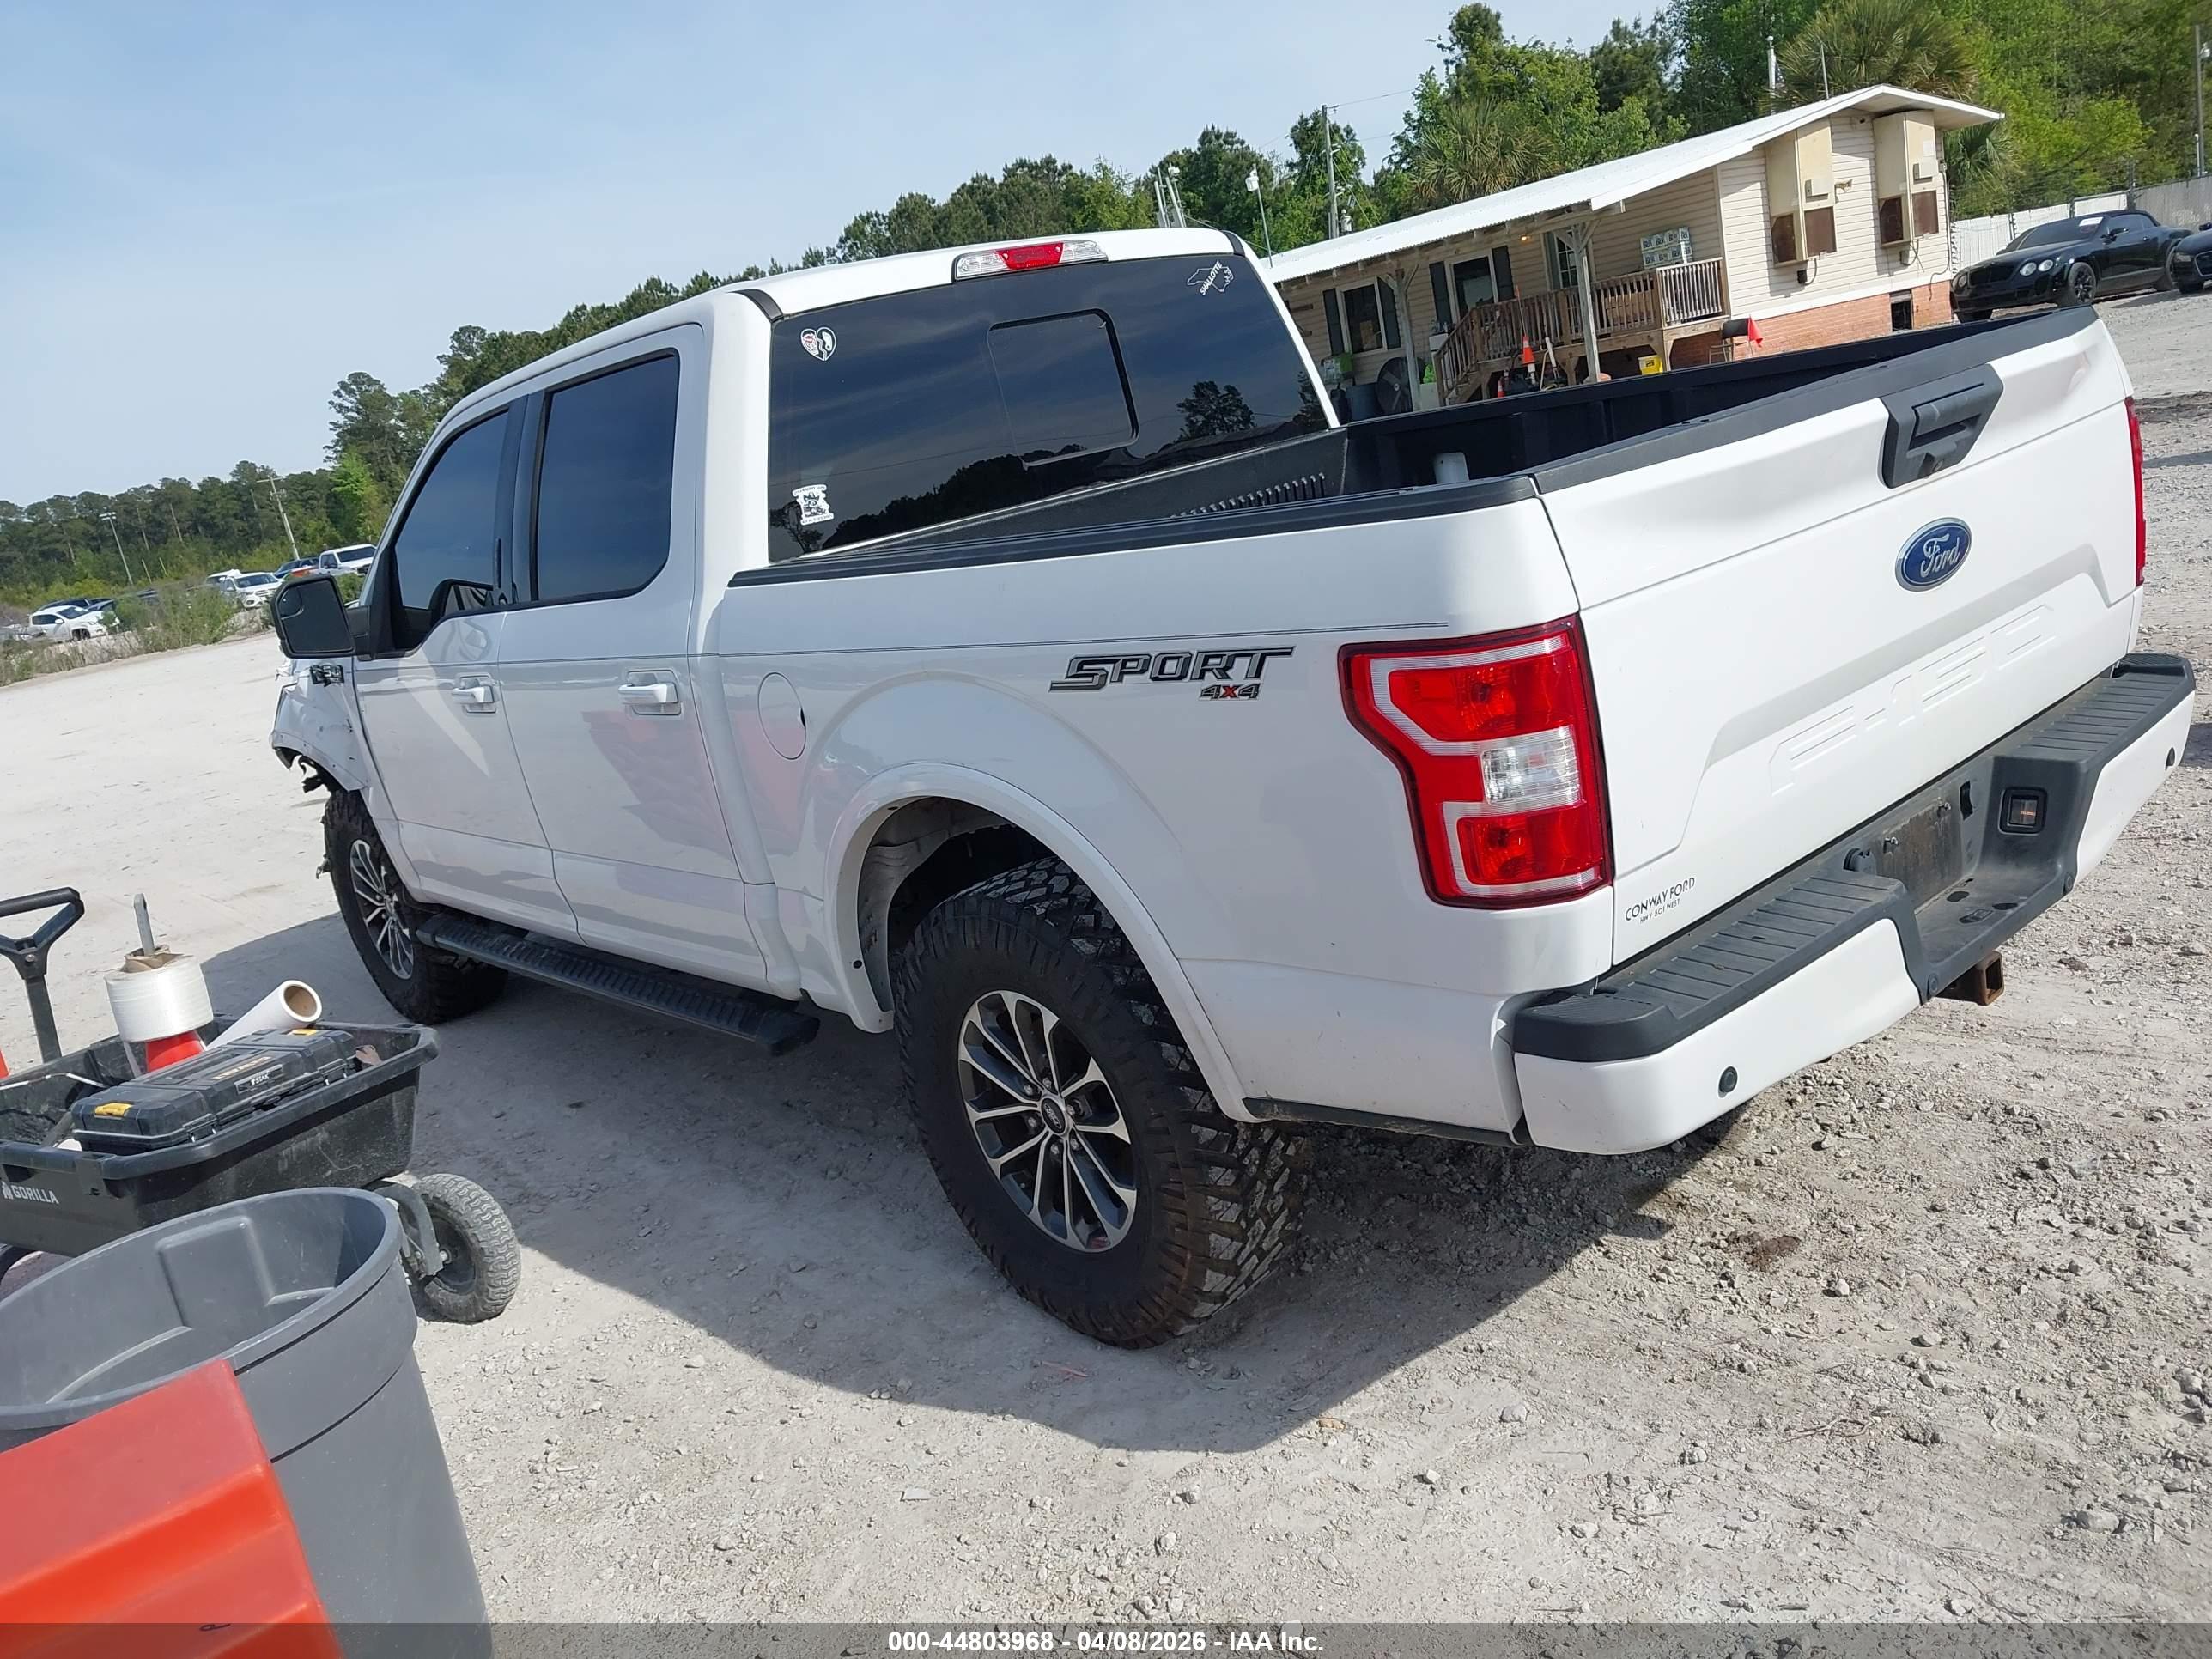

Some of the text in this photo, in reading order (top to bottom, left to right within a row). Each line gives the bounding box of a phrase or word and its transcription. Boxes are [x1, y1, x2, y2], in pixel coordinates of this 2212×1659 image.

[1919, 532, 1960, 578] Ford
[1048, 646, 1295, 692] SPORT
[1625, 877, 1696, 921] CONWAY FORD
[1639, 913, 1653, 924] HWY
[1666, 898, 1680, 910] WEST
[10, 1185, 59, 1204] GORILLA
